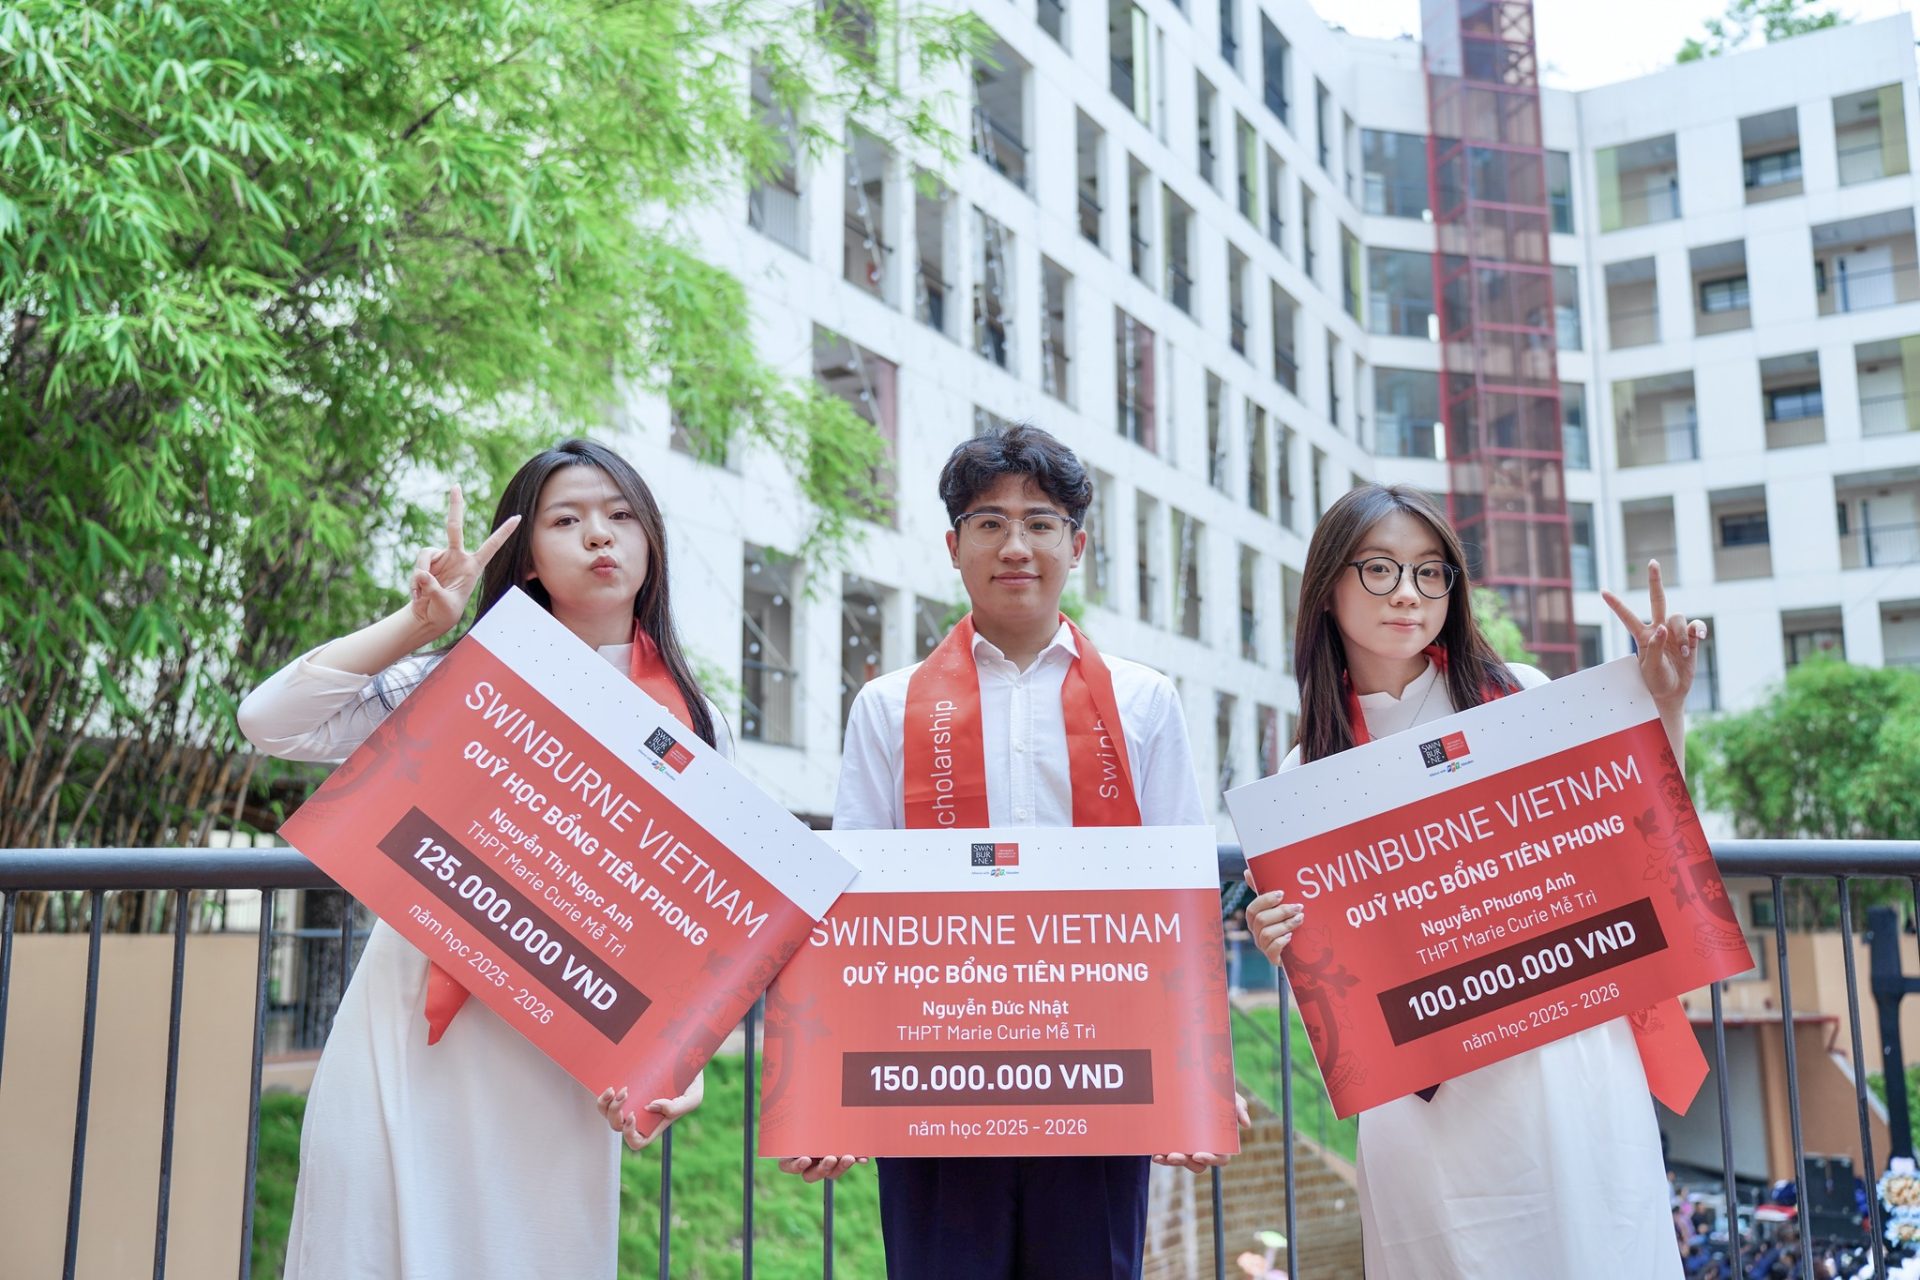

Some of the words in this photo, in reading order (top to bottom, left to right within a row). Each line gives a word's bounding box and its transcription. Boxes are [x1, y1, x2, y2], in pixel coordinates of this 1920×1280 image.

[465, 681, 642, 833] SWINBURNE
[639, 818, 769, 939] VIETNAM
[928, 700, 957, 828] cholarship
[463, 740, 510, 778] QUỸ
[502, 772, 547, 812] HỌC
[542, 804, 600, 856] BỔNG
[598, 848, 646, 894] TIÊN
[639, 885, 709, 946] PHONG
[489, 807, 544, 858] Nguyễn
[544, 850, 571, 880] Thị
[565, 870, 605, 908] Ngọc
[602, 903, 634, 932] Anh
[1296, 805, 1495, 899] SWINBURNE
[1495, 754, 1643, 828] VIETNAM
[1346, 892, 1388, 929] QUỸ
[1392, 880, 1438, 911] HỌC
[1438, 858, 1499, 895] BỔNG
[1499, 839, 1552, 872] TIÊN
[1551, 815, 1625, 855] PHONG
[413, 837, 563, 965] 125.000.000
[561, 954, 618, 1011] VND
[467, 820, 509, 857] THPT
[504, 852, 544, 891] Marie
[543, 885, 582, 922] Curie
[580, 915, 608, 940] Mễ
[604, 933, 626, 958] Trì
[809, 915, 1016, 947] SWINBURNE
[1026, 912, 1181, 944] VIETNAM
[1416, 937, 1458, 965] THPT
[1461, 924, 1506, 949] Marie
[1507, 909, 1549, 933] Curie
[1549, 895, 1574, 918] Mễ
[1574, 889, 1598, 908] Trì
[1420, 904, 1482, 937] Nguyễn
[1481, 885, 1544, 915] Phương
[1545, 872, 1576, 894] Anh
[408, 904, 442, 935] năm
[440, 927, 470, 957] học
[467, 951, 510, 987] 2025
[513, 988, 554, 1024] 2026
[843, 961, 888, 987] QUỸ
[894, 965, 940, 989] HỌC
[945, 956, 1008, 984] BỔNG
[1012, 959, 1065, 983] TIÊN
[1070, 962, 1149, 982] PHONG
[923, 998, 986, 1020] Nguyễn
[991, 1000, 1025, 1015] Đức
[1029, 999, 1069, 1018] Nhật
[1408, 942, 1574, 1021] 100.000.000
[1574, 920, 1636, 959] VND
[896, 1025, 943, 1041] THPT
[947, 1024, 993, 1041] Marie
[997, 1024, 1041, 1040] Curie
[1046, 1021, 1070, 1040] Mễ
[1073, 1023, 1096, 1039] Trì
[1462, 1031, 1497, 1052] năm
[1497, 1019, 1529, 1039] học
[1528, 1000, 1569, 1028] 2025
[1579, 982, 1620, 1009] 2026
[870, 1064, 1052, 1091] 150.000.000
[1058, 1063, 1124, 1089] VND
[909, 1120, 945, 1136] năm
[950, 1119, 982, 1139] học
[985, 1119, 1029, 1136] 2025
[1044, 1118, 1087, 1135] 2026
